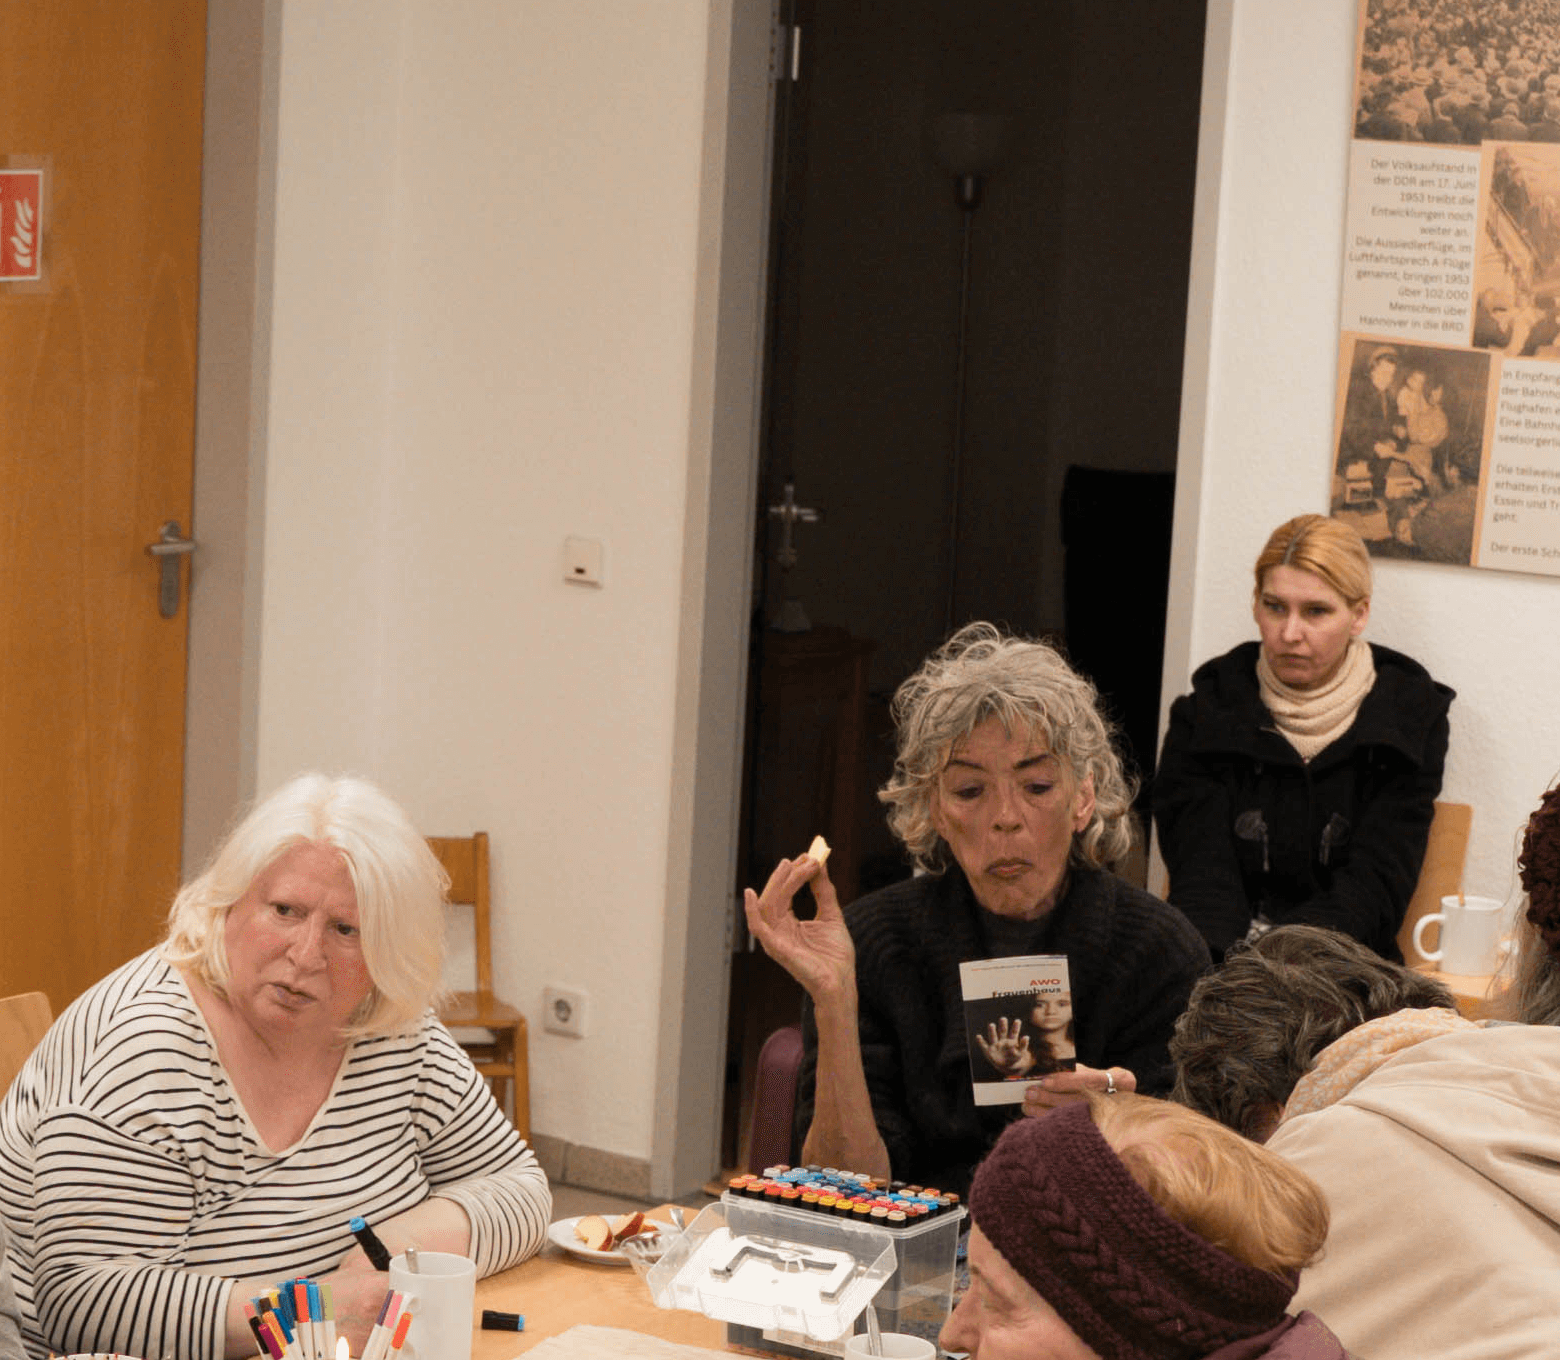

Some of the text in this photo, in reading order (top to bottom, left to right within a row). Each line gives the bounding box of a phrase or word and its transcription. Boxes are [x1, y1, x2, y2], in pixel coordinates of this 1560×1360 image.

[1371, 158, 1389, 169] Der
[1392, 159, 1465, 173] Volksaufstand
[1373, 175, 1391, 185] der
[1355, 235, 1372, 247] Die
[1029, 978, 1061, 987] AWO
